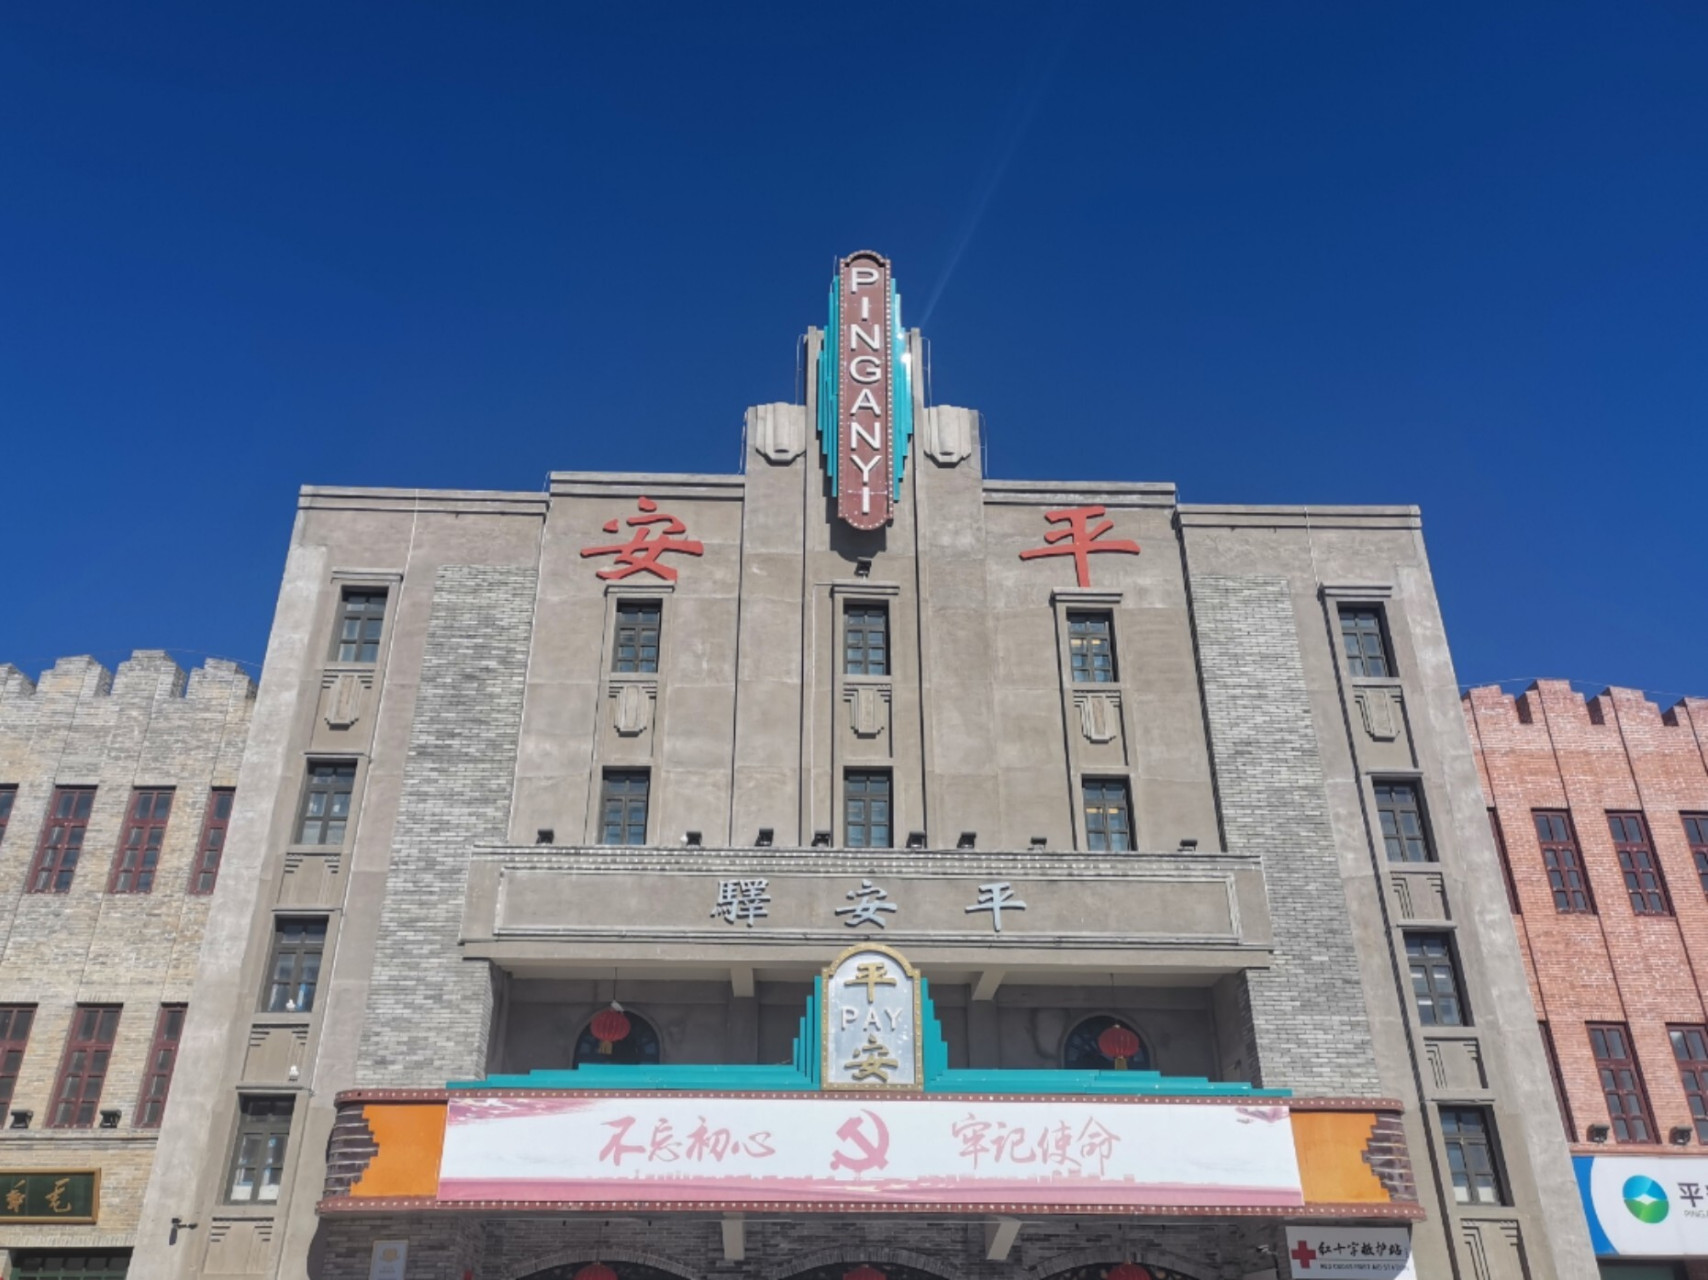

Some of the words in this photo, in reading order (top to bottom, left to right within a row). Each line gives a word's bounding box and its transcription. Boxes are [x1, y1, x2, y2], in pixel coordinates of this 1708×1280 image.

[849, 266, 882, 514] PINGANYI
[840, 1005, 904, 1032] PAY
[598, 1115, 776, 1166] 不忘初心
[951, 1112, 1121, 1176] 牢记使命
[1676, 1182, 1708, 1208] 平
